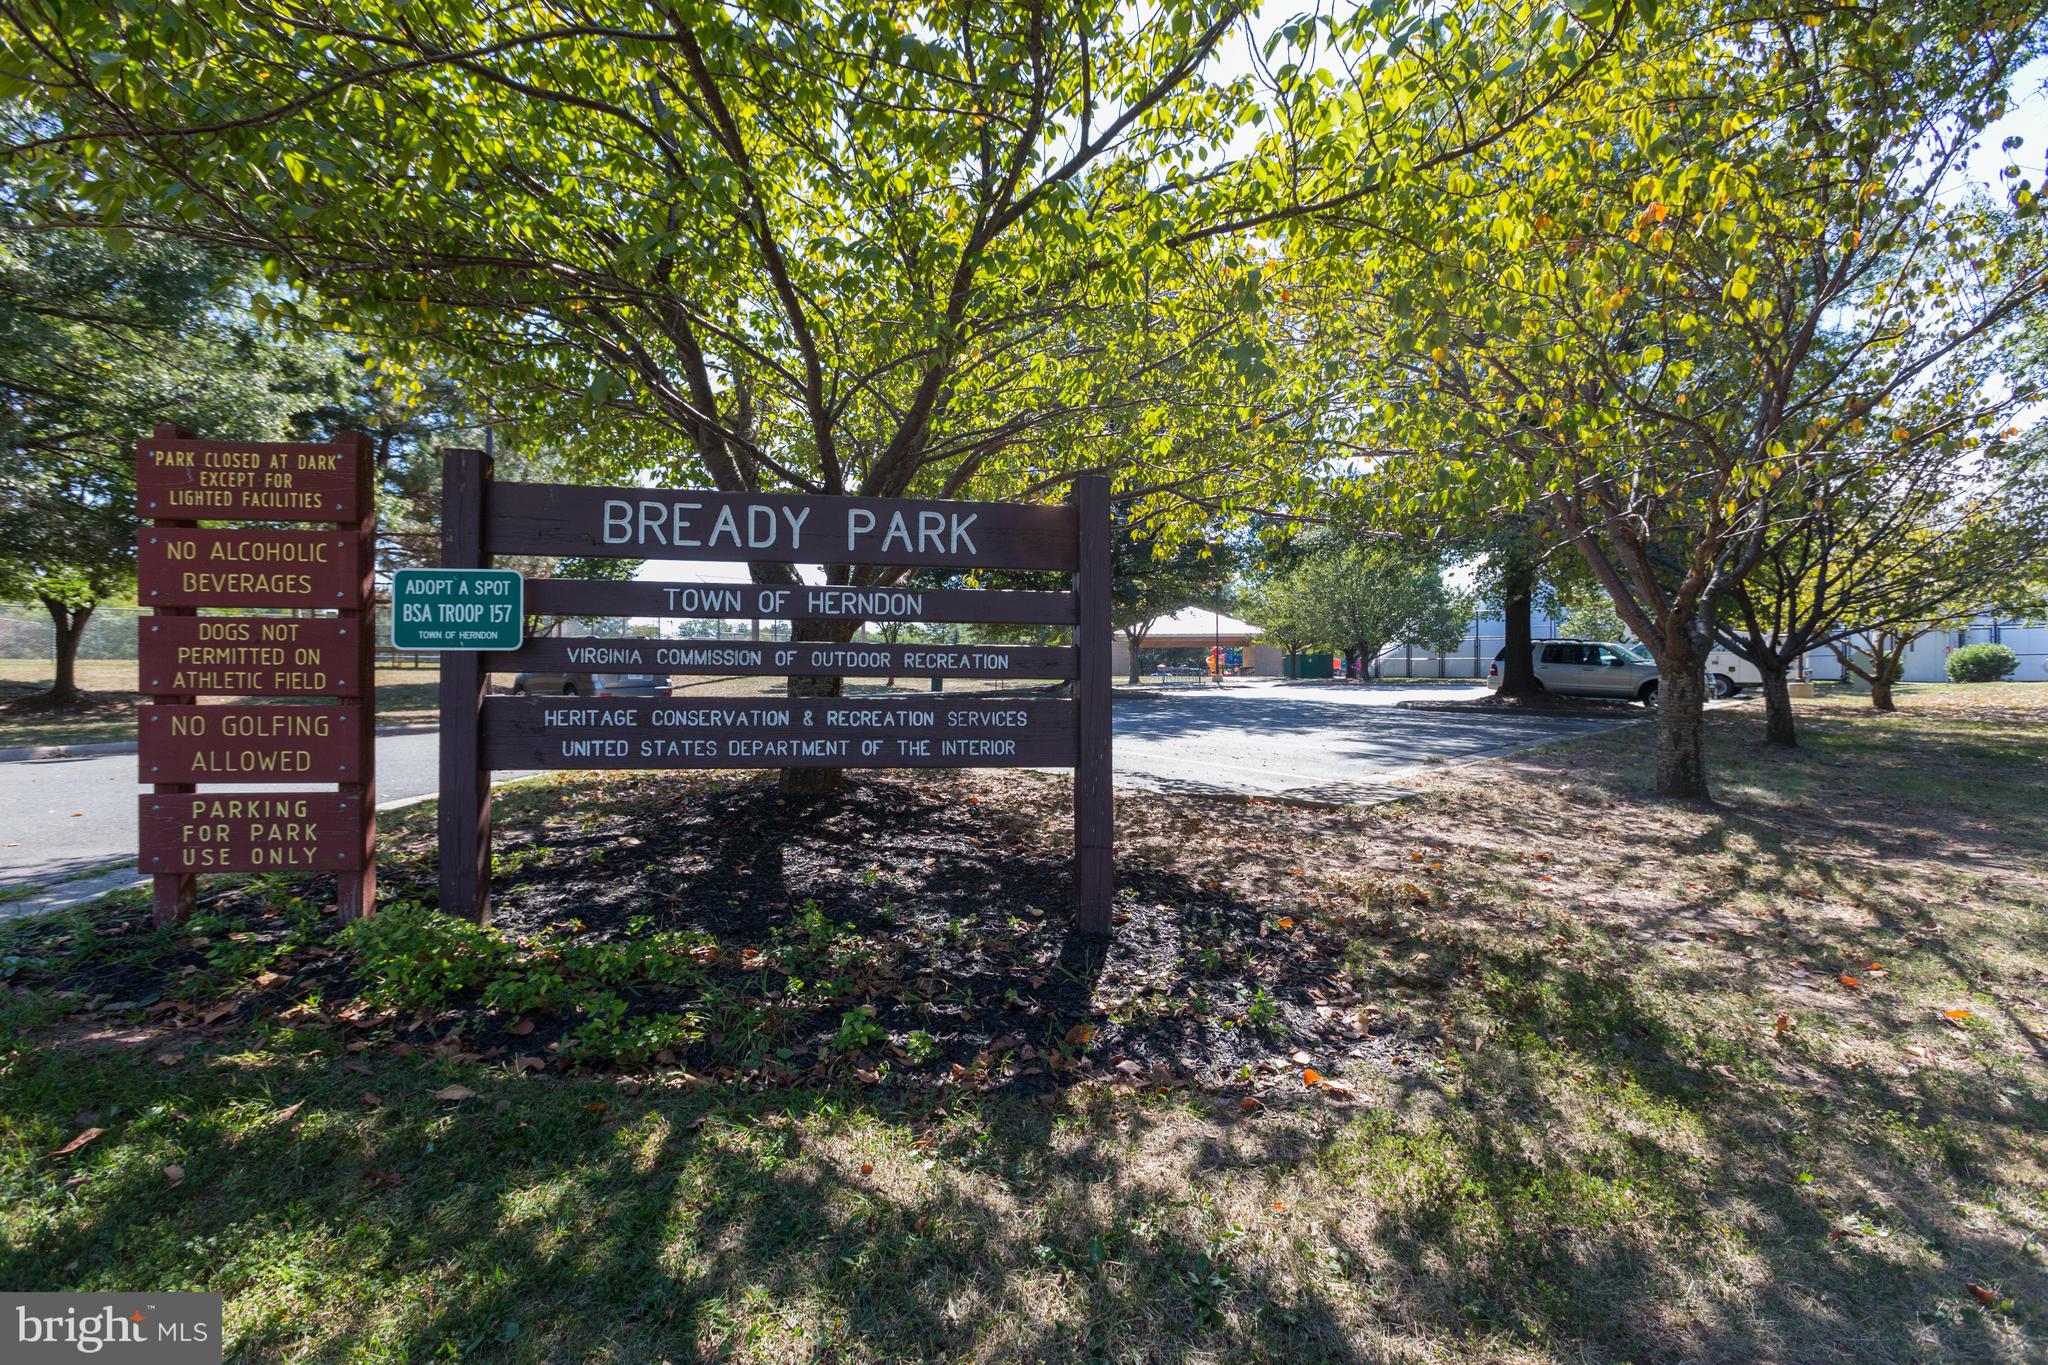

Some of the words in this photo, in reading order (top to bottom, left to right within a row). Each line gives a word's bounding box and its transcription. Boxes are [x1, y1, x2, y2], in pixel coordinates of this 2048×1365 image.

[155, 451, 194, 467] PARK
[204, 452, 260, 469] CLOSED
[270, 455, 288, 469] AT
[298, 455, 336, 470] DARK
[201, 472, 254, 487] EXCEPT
[265, 473, 292, 488] FOR
[170, 490, 232, 506] LIGHTED
[242, 492, 322, 508] FACILITIES
[602, 500, 810, 550] BREADY
[847, 508, 978, 555] PARK
[167, 541, 196, 560] NO
[210, 542, 327, 562] ALCOHOLIC
[183, 573, 312, 593] BEVERAGES
[405, 580, 453, 594] ADOPT
[459, 581, 468, 595] A
[475, 581, 510, 595] SPOT
[663, 588, 741, 613] TOWN
[759, 590, 791, 613] OF
[808, 591, 923, 616] HERNDON
[403, 604, 432, 622] BSA
[438, 604, 484, 622] TROOP
[490, 605, 512, 622] 157
[199, 623, 249, 641] DOGS
[262, 624, 299, 641] NOT
[445, 631, 456, 639] OF
[178, 647, 284, 665] PERMITTED
[295, 648, 320, 665] ON
[567, 647, 642, 665] VIRGINIA
[657, 648, 761, 666] COMMISSION
[775, 650, 798, 666] OF
[812, 651, 891, 668] OUTDOOR
[904, 652, 1009, 669] RECREATION
[173, 672, 263, 689] ATHLETIC
[275, 672, 326, 689] FIELD
[172, 715, 205, 736] NO
[222, 716, 329, 736] GOLFING
[545, 710, 637, 726] HERITAGE
[651, 710, 789, 726] CONSERVATION
[804, 711, 813, 726] &
[827, 711, 934, 726] RECREATION
[948, 711, 1028, 726] SERVICES
[562, 740, 628, 757] UNITED
[641, 740, 717, 757] STATES
[728, 740, 850, 756] DEPARTMENT
[861, 740, 883, 756] OF
[898, 740, 930, 756] THE
[943, 740, 1016, 756] INTERIOR
[191, 751, 311, 772] ALLOWED
[192, 801, 307, 819] PARKING
[183, 825, 229, 842] FOR
[251, 824, 317, 841] PARK
[183, 849, 230, 865] USE
[252, 848, 317, 864] ONLY
